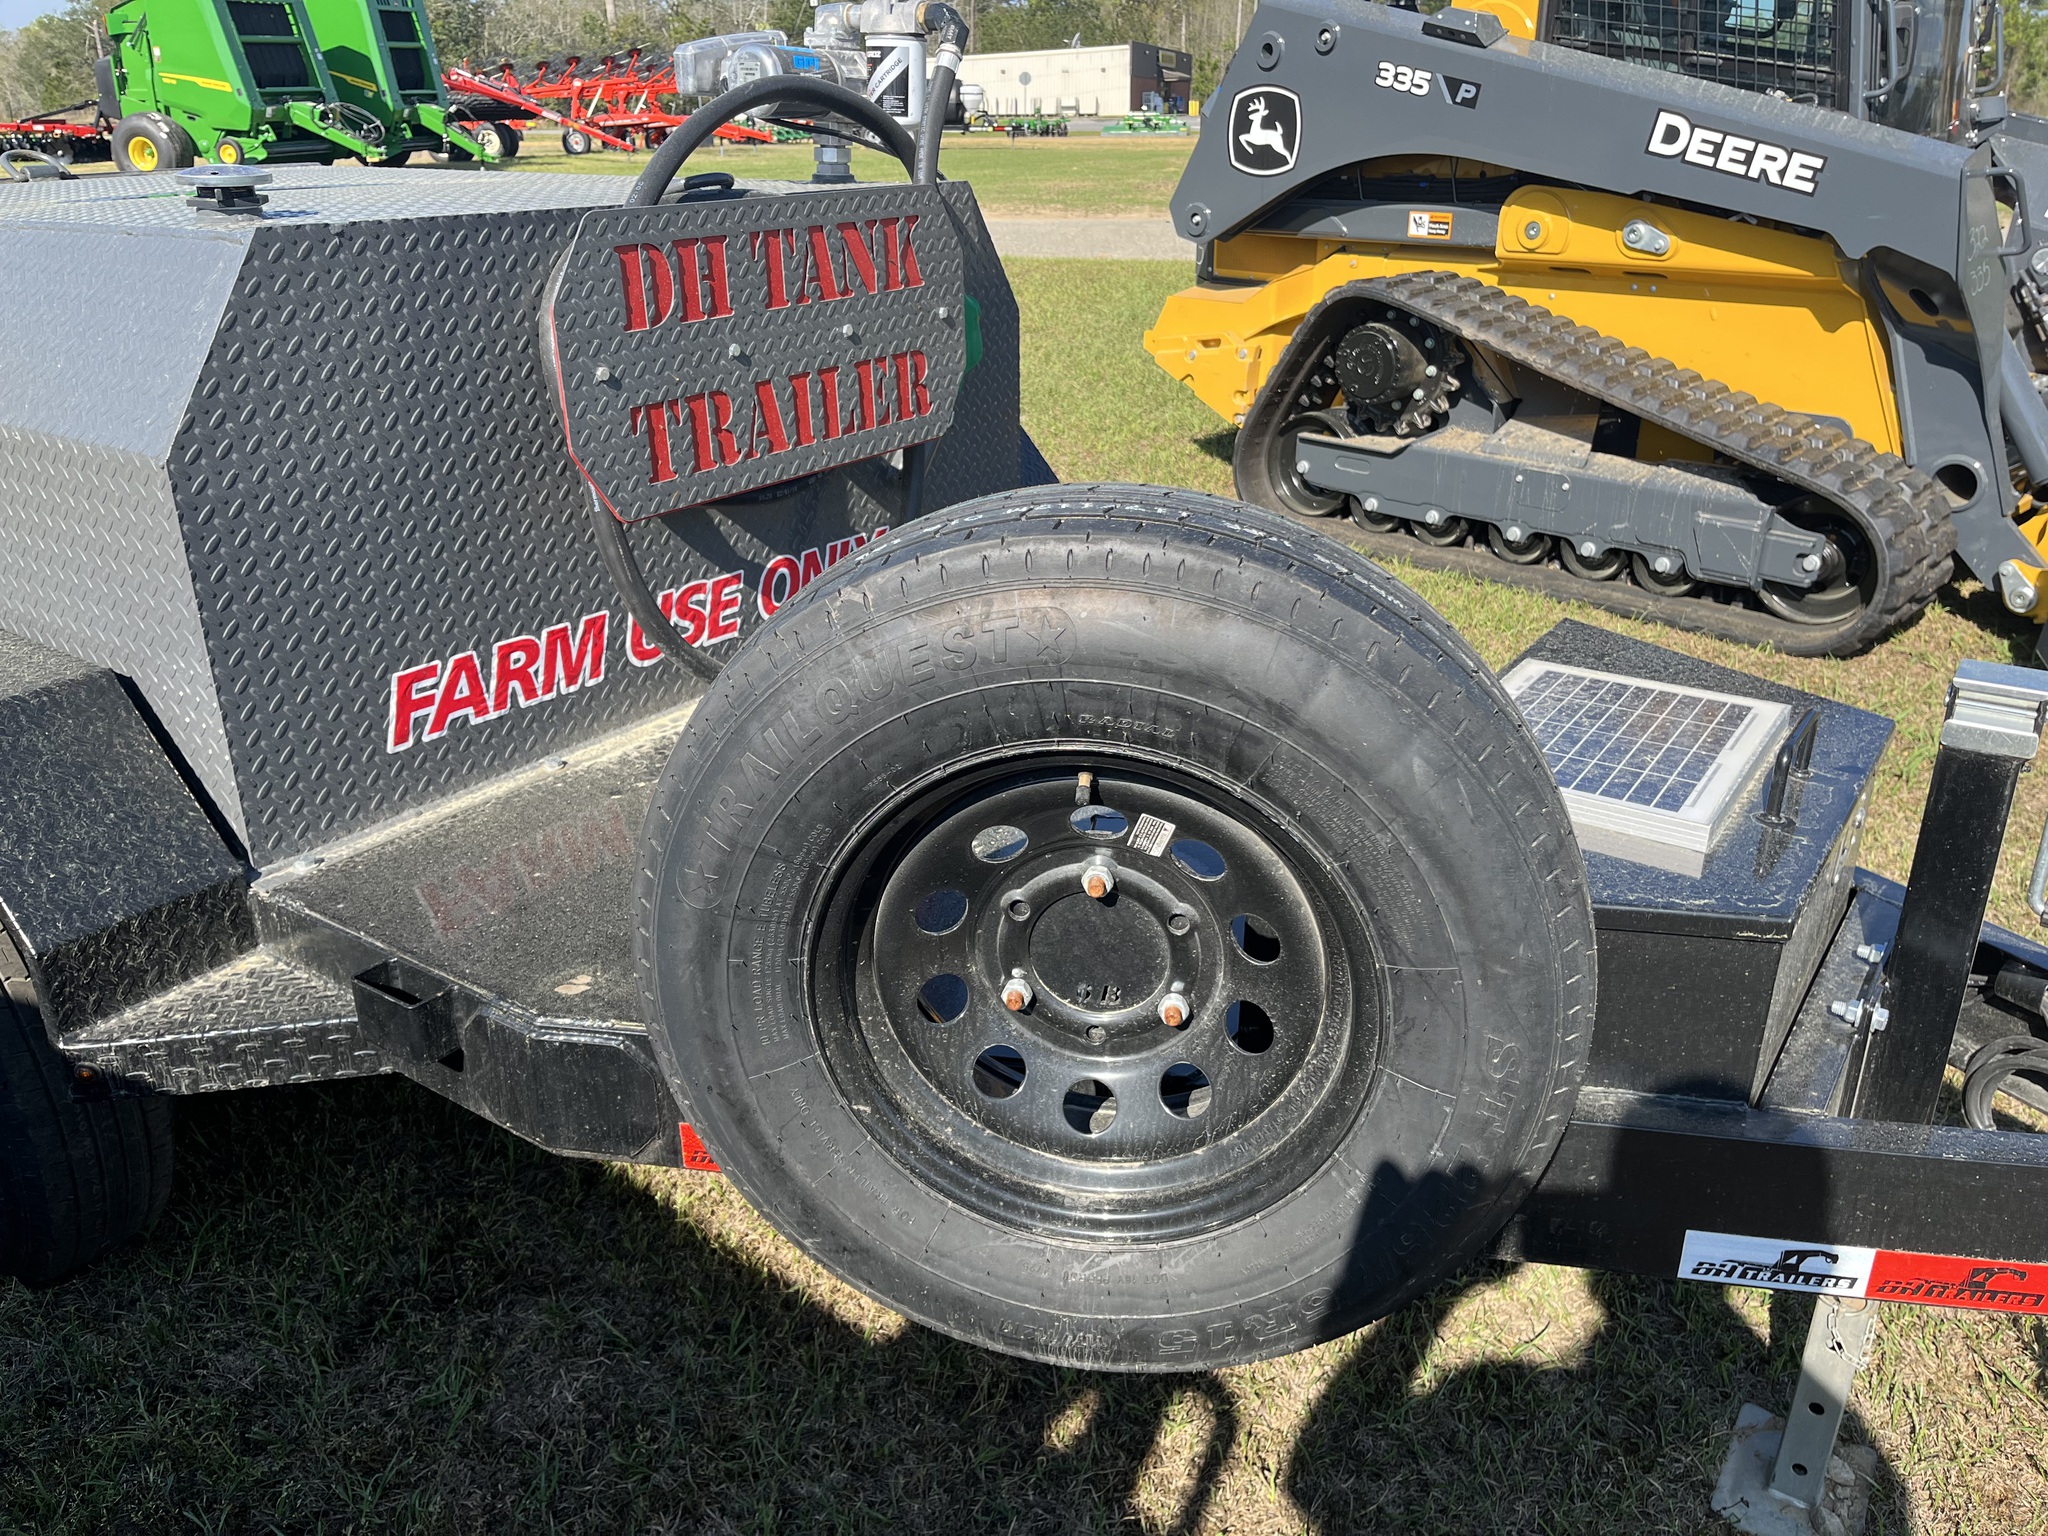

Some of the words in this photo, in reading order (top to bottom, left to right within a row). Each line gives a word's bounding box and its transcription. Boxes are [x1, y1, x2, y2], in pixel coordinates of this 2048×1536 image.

[875, 57, 903, 88] CARTRIDGE
[1375, 61, 1432, 96] 335
[1647, 110, 1825, 194] DEERE
[614, 234, 734, 333] DH
[750, 215, 925, 311] TANK
[630, 350, 934, 486] TRAILER
[387, 612, 608, 754] FARM
[627, 571, 743, 667] USE
[758, 526, 889, 620] ON
[701, 616, 1021, 857] TRAILQUEST
[1078, 714, 1176, 738] RADIAL
[1277, 754, 1321, 786] SAFETY
[807, 822, 824, 843] COLD
[816, 826, 832, 845] COLD
[758, 859, 788, 919] TUBELESS
[755, 921, 767, 932] E
[750, 934, 764, 976] RANGE
[751, 979, 763, 1011] LOAD
[754, 1014, 766, 1030] PR
[766, 1005, 775, 1024] LOAD
[776, 1003, 785, 1022] LOAD
[759, 1035, 771, 1045] 10
[771, 1026, 780, 1042] MAX
[779, 1024, 789, 1039] MAX
[1476, 1034, 1524, 1134] ST
[788, 1086, 811, 1116] ONLY
[806, 1117, 847, 1164] SERVICE
[843, 1163, 891, 1207] TRAILER
[890, 1204, 917, 1225] FOR
[1691, 1261, 1740, 1278] DH
[1742, 1268, 1856, 1290] TRAILERS
[1877, 1280, 1927, 1296] DH
[1930, 1286, 2041, 1307] TRAILERS
